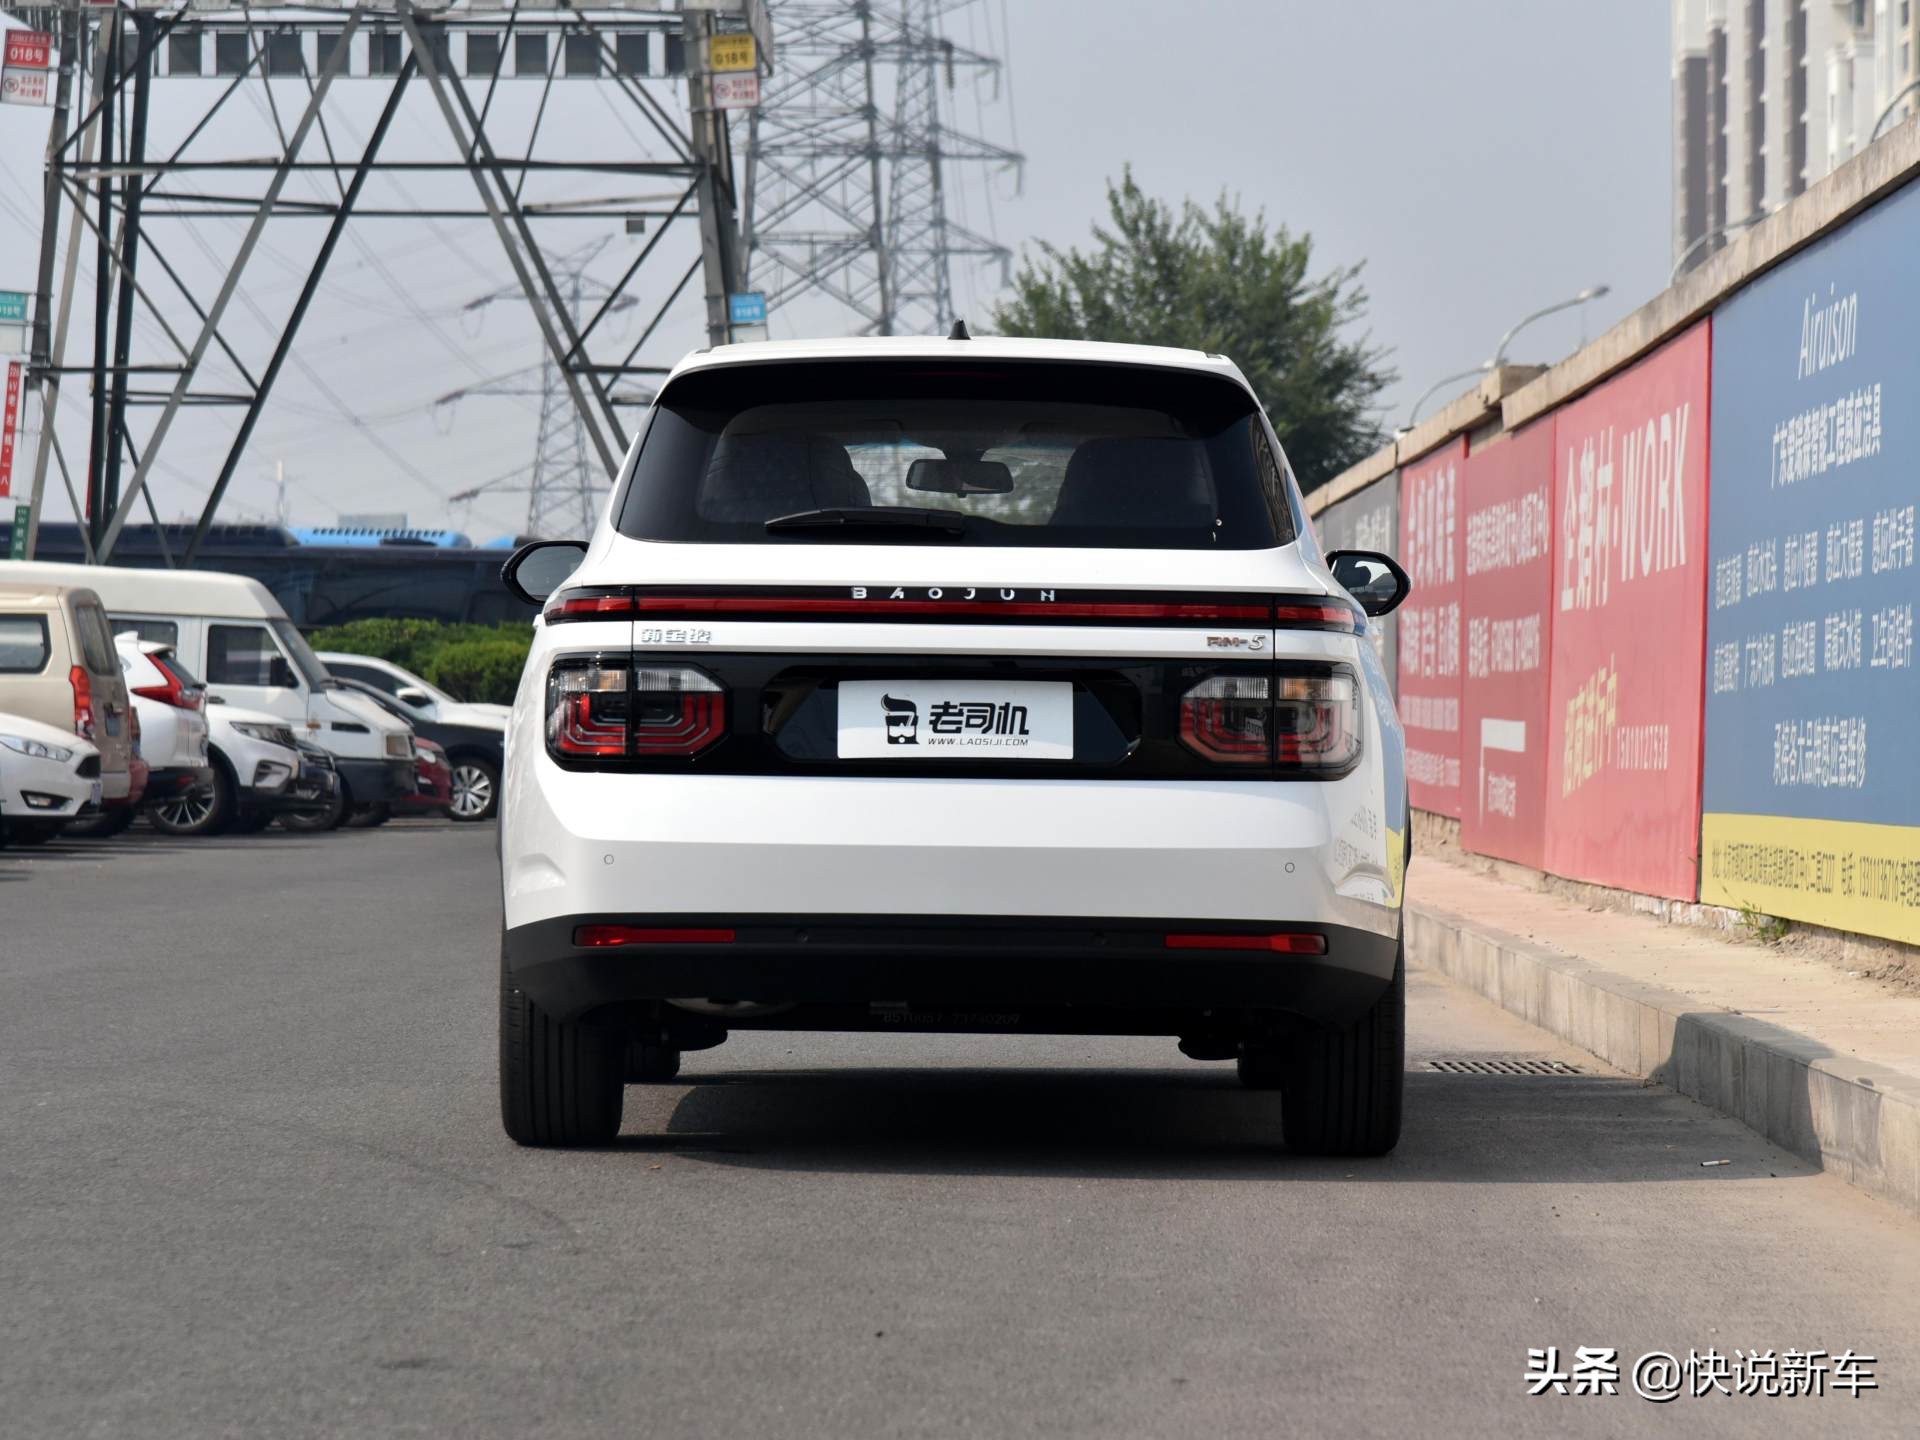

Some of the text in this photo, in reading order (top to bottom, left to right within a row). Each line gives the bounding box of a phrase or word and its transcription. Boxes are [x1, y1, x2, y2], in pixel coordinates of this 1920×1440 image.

[1798, 281, 1857, 380] Airuison
[1622, 403, 1690, 583] WORK
[851, 586, 1056, 602] BAOJUN
[929, 701, 1029, 735] 老司机
[928, 737, 1029, 747] WWW.LAOSIJI.COM
